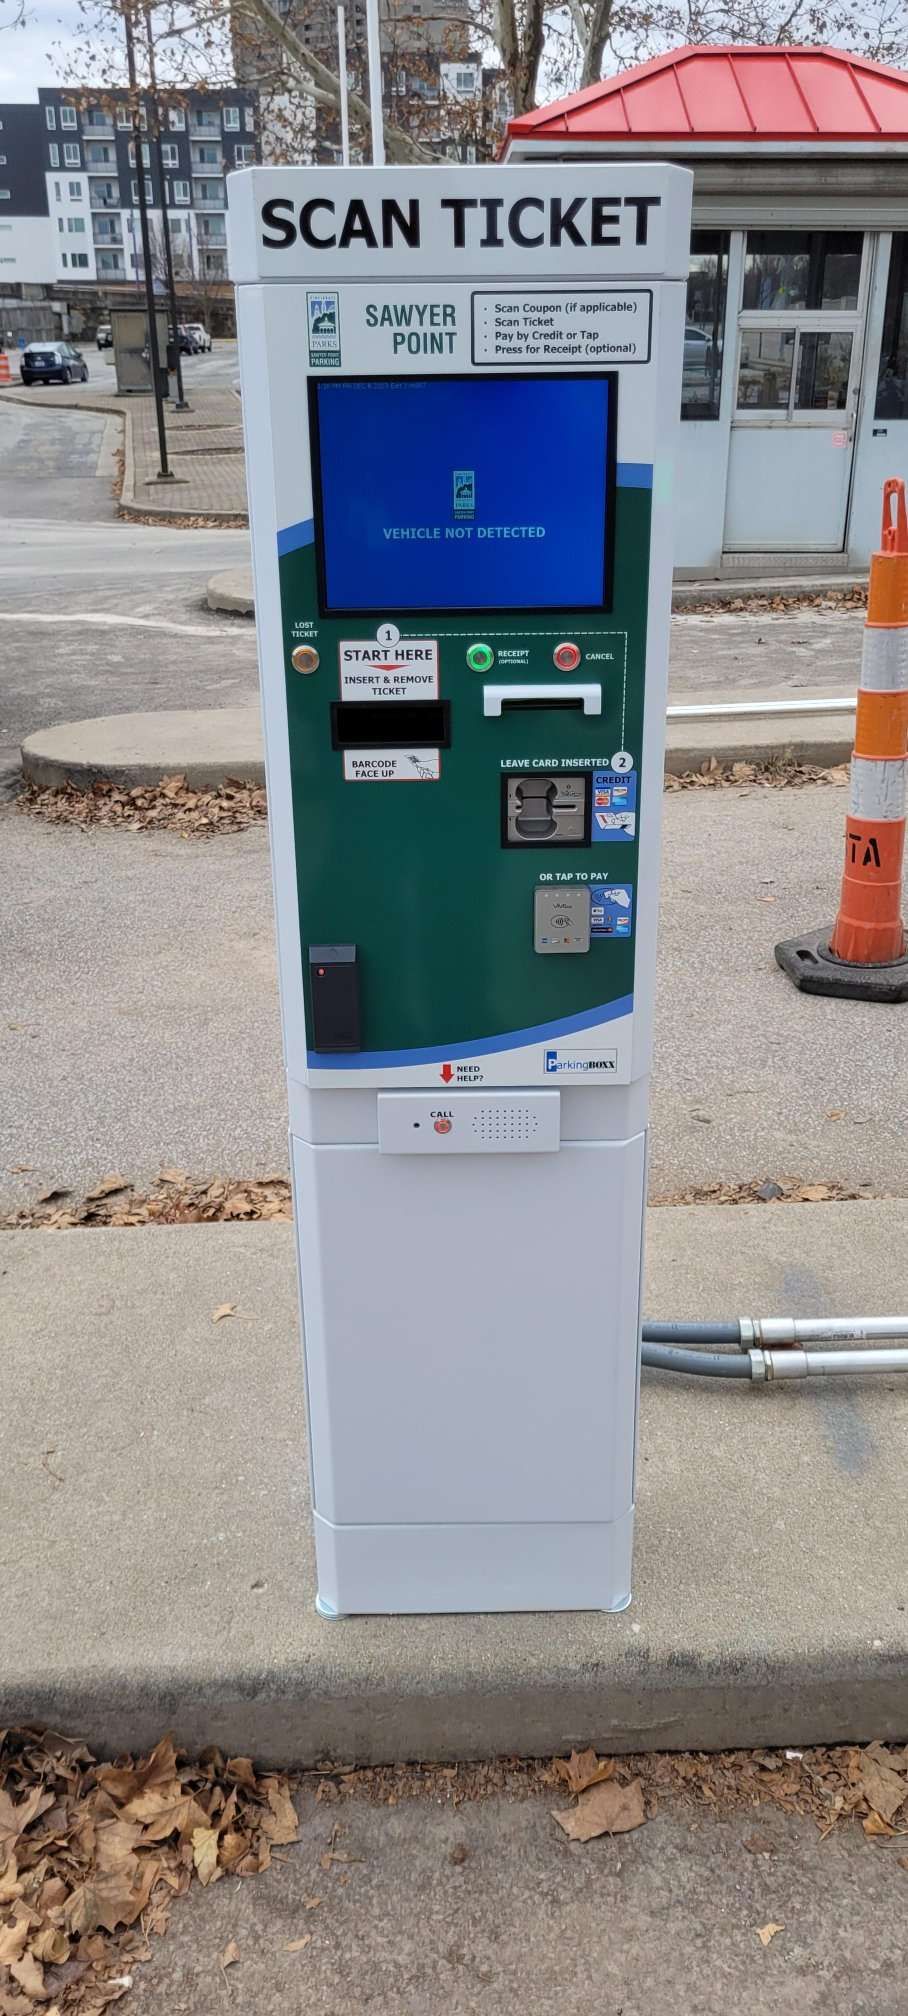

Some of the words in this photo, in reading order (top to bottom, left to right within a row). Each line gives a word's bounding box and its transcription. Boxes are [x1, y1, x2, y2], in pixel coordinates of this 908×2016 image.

[261, 198, 421, 249] SCAN
[441, 196, 661, 249] TICKET
[494, 304, 520, 313] Scan
[522, 303, 562, 315] Coupon
[565, 302, 577, 314] (if
[579, 301, 638, 314] applicable)
[365, 304, 457, 327] SAWYER
[494, 317, 520, 327] Scan
[523, 317, 555, 327] Ticket
[495, 331, 514, 342] Pay
[517, 331, 530, 342] by
[532, 330, 564, 340] Credit
[566, 332, 577, 340] or
[579, 330, 599, 342] Tap
[393, 332, 457, 354] POINT
[495, 344, 523, 354] Press
[525, 344, 540, 354] for
[543, 344, 582, 355] Receipt
[585, 343, 637, 355] (optional)
[311, 358, 340, 366] PARKING
[383, 527, 441, 539] VEHICLE
[445, 527, 473, 538] NOT
[477, 526, 546, 538] DETECTED
[291, 630, 319, 638] TICKET
[385, 630, 393, 641] 1
[343, 649, 391, 661] START
[395, 649, 433, 661] HERE
[344, 676, 381, 684] INSERT
[383, 676, 391, 684] &
[393, 675, 434, 684] REMOVE
[372, 687, 407, 695] TICKET
[352, 760, 398, 768] BARCODE
[500, 759, 530, 768] LEAVE
[532, 759, 559, 767] CARD
[561, 758, 609, 767] INSERTED
[618, 758, 627, 768] 2
[355, 770, 379, 778] FACE
[595, 776, 632, 784] CREDIT
[539, 873, 554, 881] OR
[575, 872, 588, 880] TO
[590, 872, 609, 880] PAY
